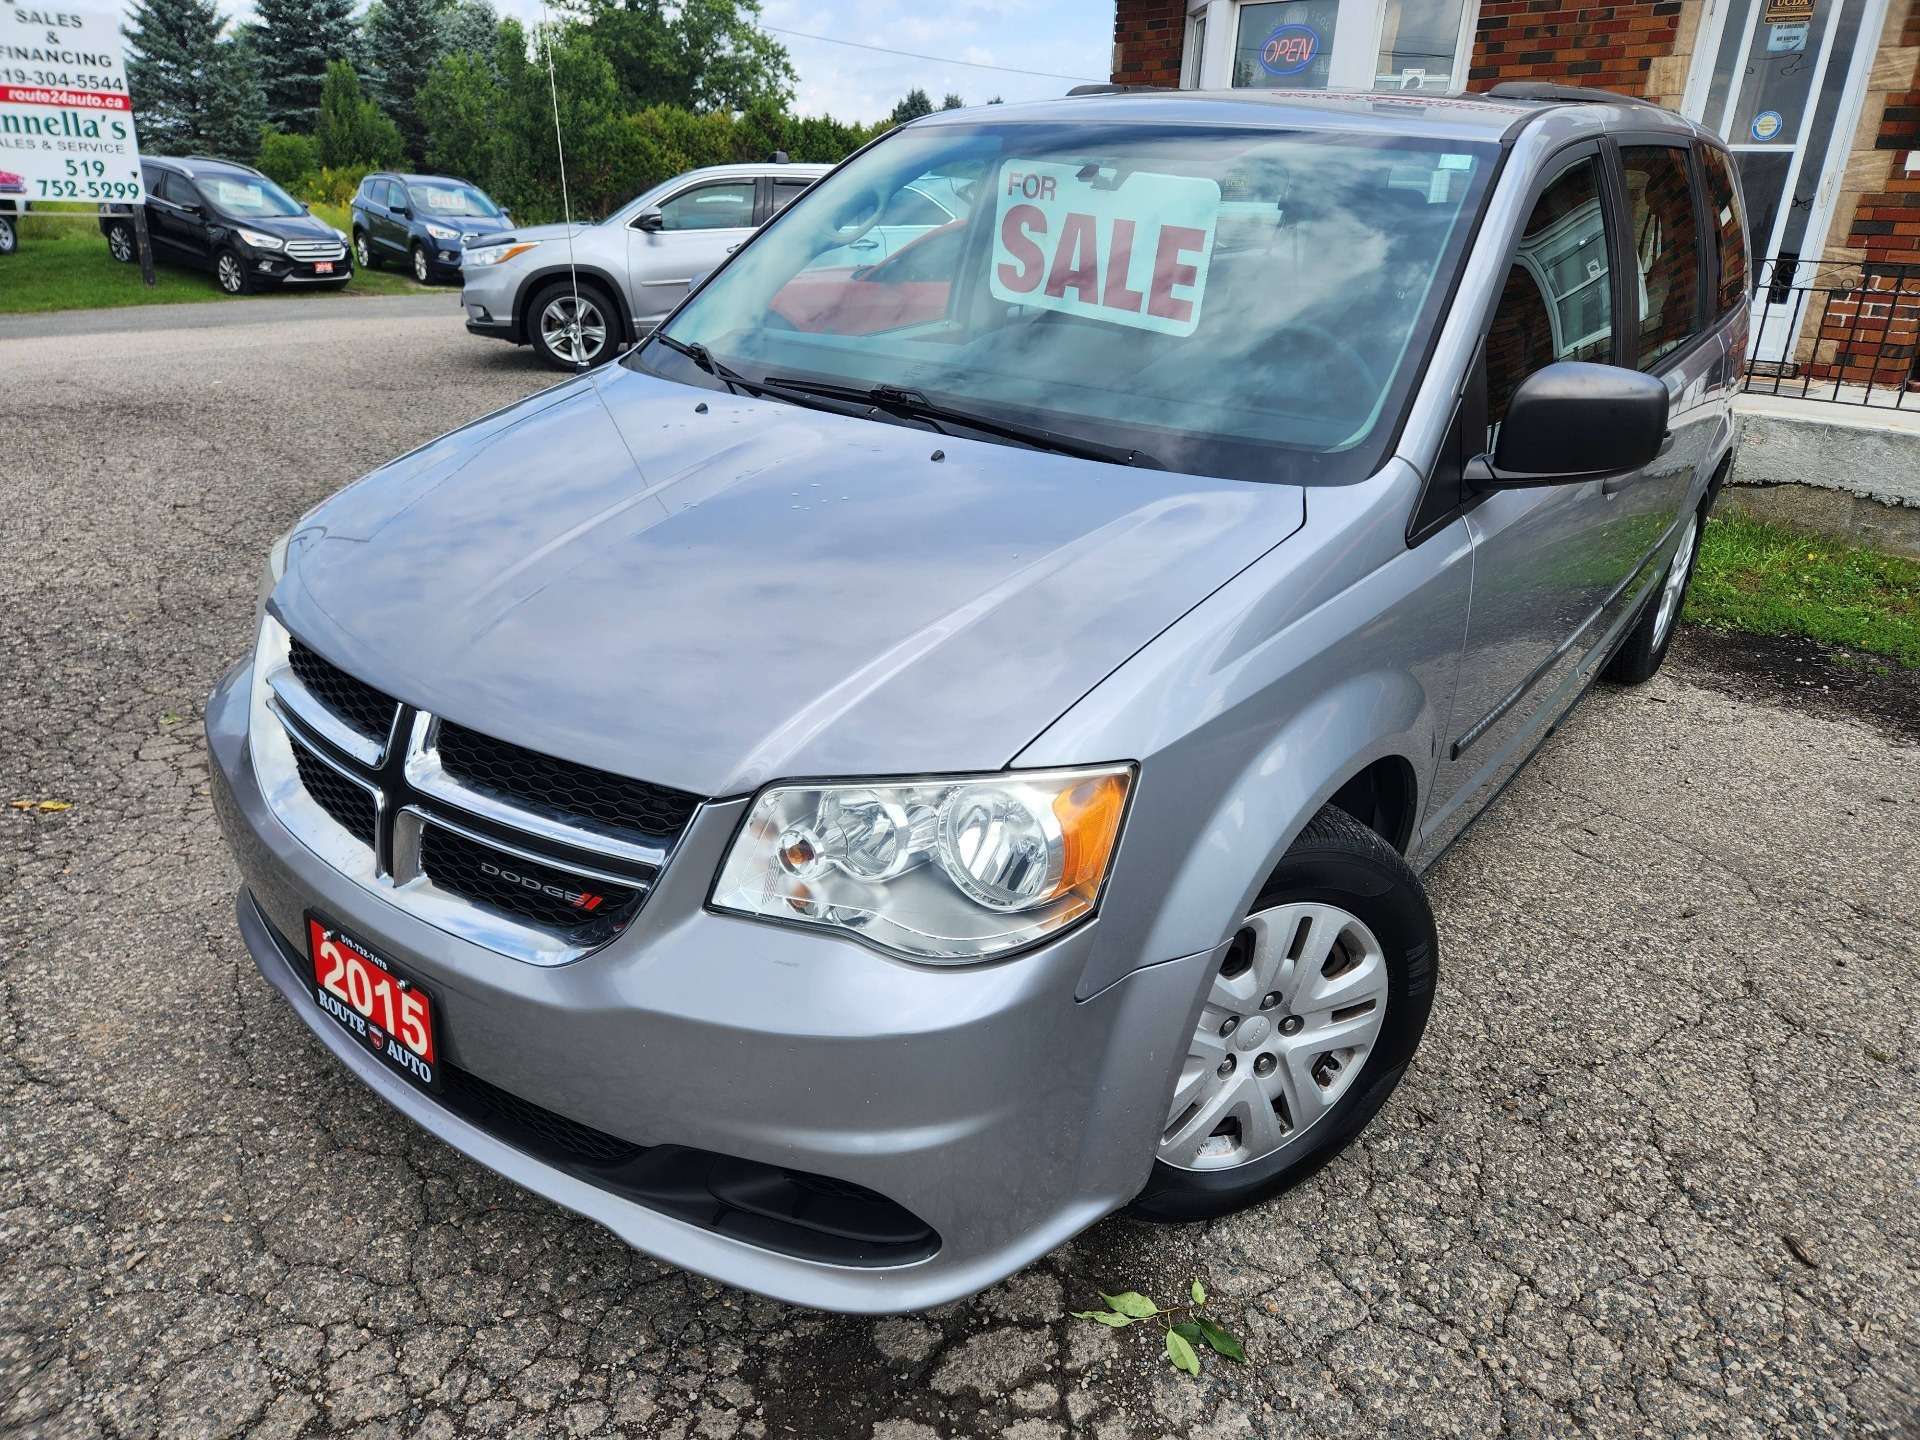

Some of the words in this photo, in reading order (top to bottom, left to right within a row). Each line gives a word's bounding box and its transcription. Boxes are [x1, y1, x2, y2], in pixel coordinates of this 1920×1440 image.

[15, 8, 82, 28] SALES
[46, 31, 60, 44] &
[1263, 37, 1315, 63] OPEN
[0, 67, 123, 91] 19-304-5544
[8, 88, 124, 109] route24auto.ca
[42, 141, 52, 150] &
[57, 141, 125, 154] SERVICE
[65, 159, 105, 177] 519
[36, 179, 139, 199] 752-5299
[1008, 172, 1057, 201] FOR
[997, 204, 1207, 323] SALE
[480, 862, 586, 907] DODGE
[320, 941, 428, 1056] 2015
[317, 988, 367, 1037] ROUTE
[386, 1039, 432, 1083] AUTO
